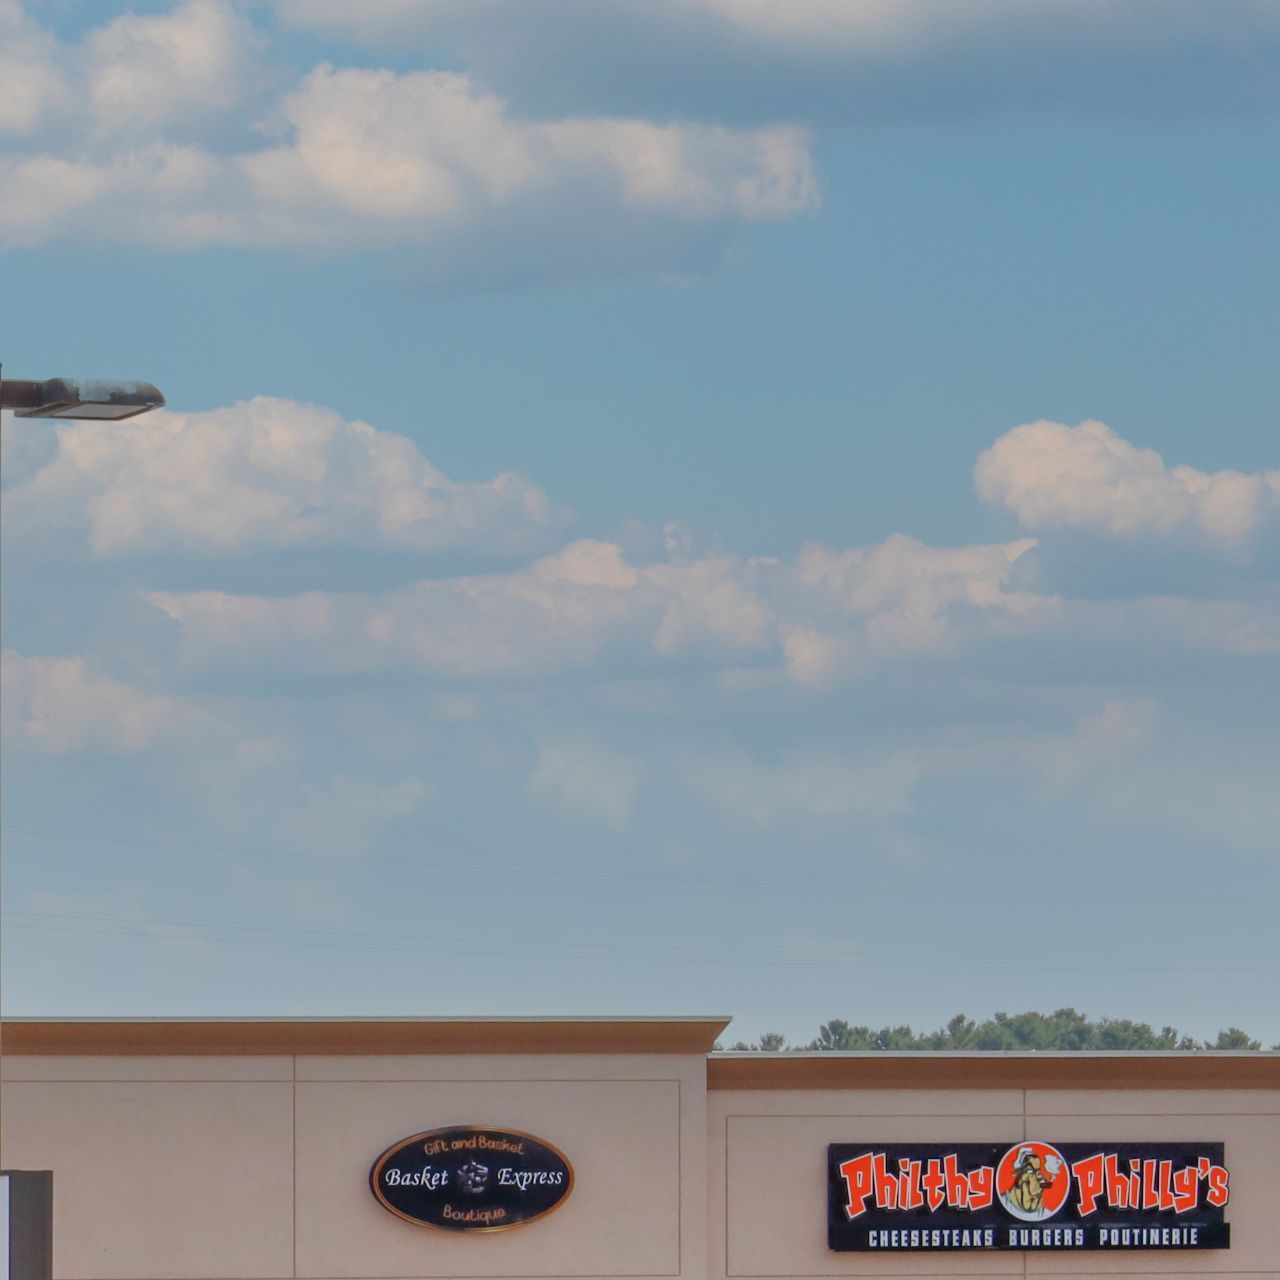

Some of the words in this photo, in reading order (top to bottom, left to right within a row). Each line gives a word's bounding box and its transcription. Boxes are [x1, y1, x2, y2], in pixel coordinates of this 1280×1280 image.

[424, 1139, 447, 1155] Gift
[451, 1136, 477, 1150] and
[478, 1134, 525, 1155] Basket
[385, 1165, 449, 1190] Basket
[497, 1167, 564, 1191] Express
[839, 1151, 994, 1220] Philthy
[1071, 1151, 1229, 1218] Philly's
[443, 1203, 507, 1225] Boutique
[868, 1229, 994, 1248] CHEESESTEAKS
[1008, 1229, 1085, 1247] BURGERS
[1099, 1228, 1198, 1246] POUTINERIE
